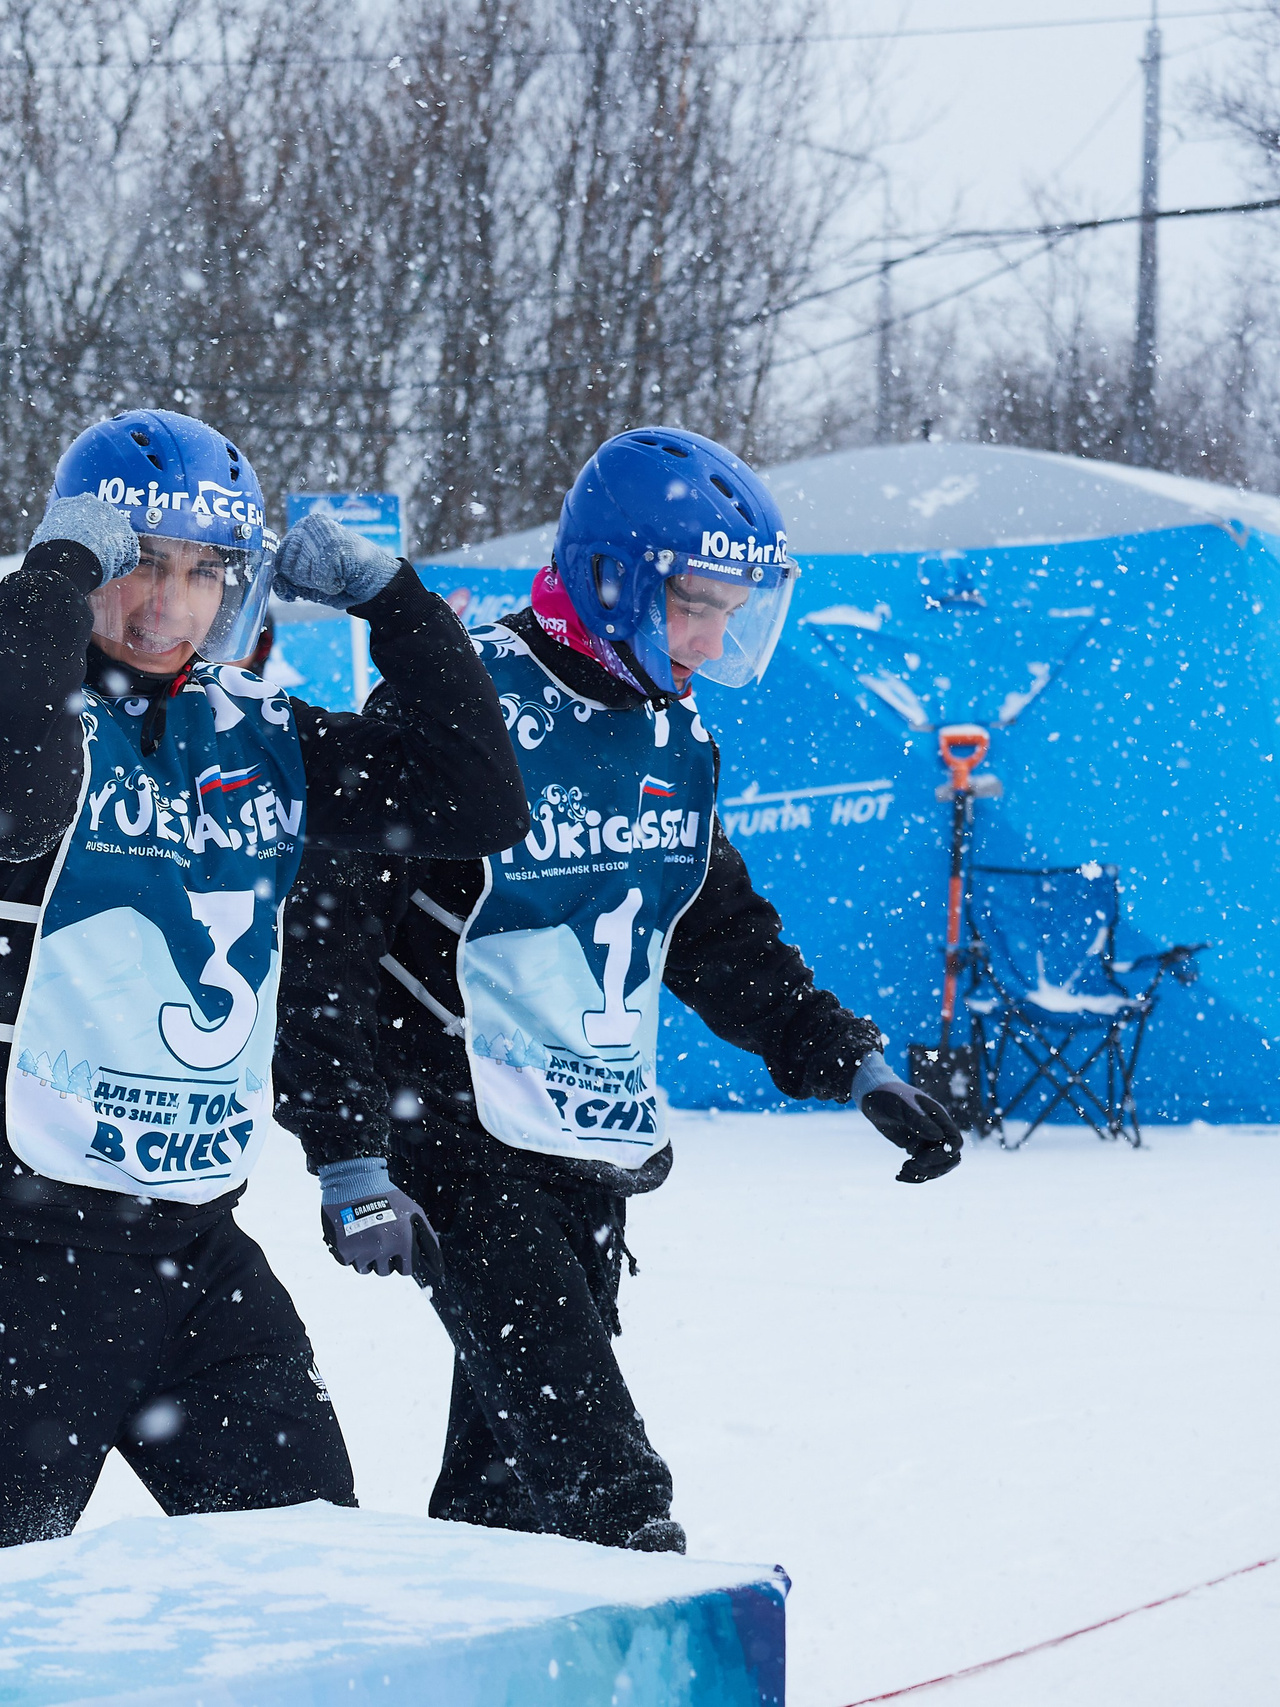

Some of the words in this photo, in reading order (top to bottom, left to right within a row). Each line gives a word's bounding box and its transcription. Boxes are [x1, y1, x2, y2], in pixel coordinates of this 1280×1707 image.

[687, 558, 743, 577] МУРМАНСК
[830, 793, 895, 827] HOT
[541, 865, 590, 879] MURMANSK
[592, 861, 629, 873] REGION
[158, 888, 259, 1071] 3
[582, 887, 644, 1049] 1
[549, 1054, 580, 1073] ДЛЯ
[93, 1081, 141, 1103] ДЛЯ
[545, 1071, 576, 1087] КТО
[578, 1077, 622, 1095] ЗНАЕТ
[93, 1101, 127, 1119] КТО
[128, 1108, 178, 1125] ЗНАЕТ
[90, 1120, 126, 1163] В
[354, 1200, 387, 1216] GRANBERG
